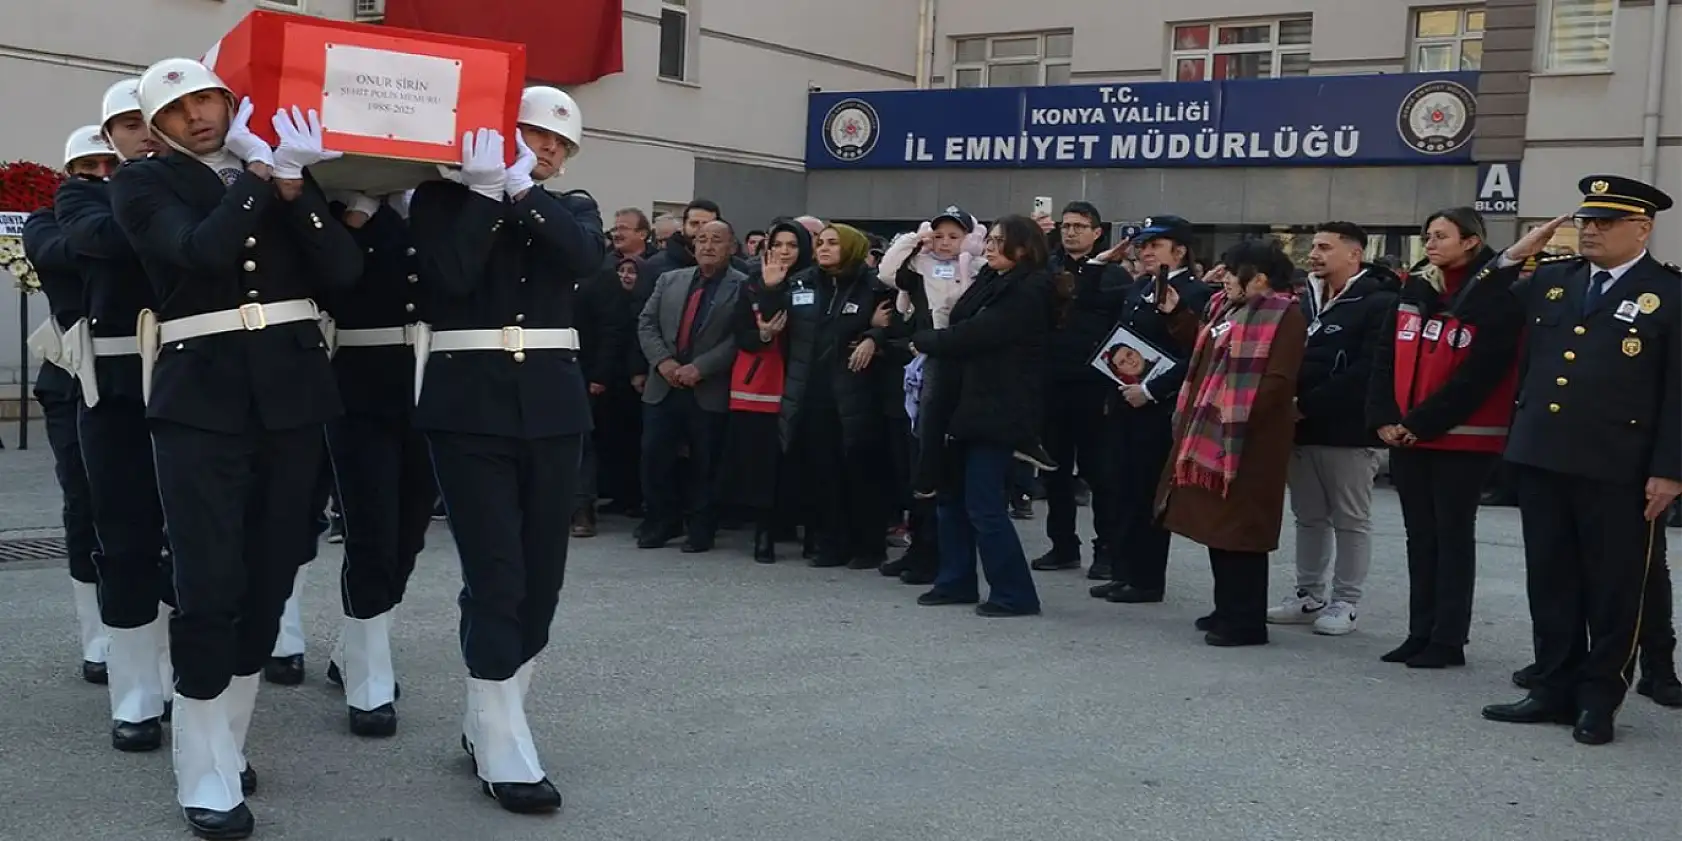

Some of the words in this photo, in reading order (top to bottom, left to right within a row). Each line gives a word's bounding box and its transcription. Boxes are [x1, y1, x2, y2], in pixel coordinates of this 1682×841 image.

[356, 74, 392, 88] ONUR
[1099, 87, 1139, 103] T.C.
[1031, 108, 1106, 125] KONYA
[1112, 101, 1210, 123] VALİLİĞİ
[904, 132, 934, 161] İL
[945, 131, 1099, 161] EMNİYET
[1110, 125, 1360, 160] MÜDÜRLÜĞÜ
[1480, 163, 1515, 199] A
[1475, 201, 1517, 212] BLOK
